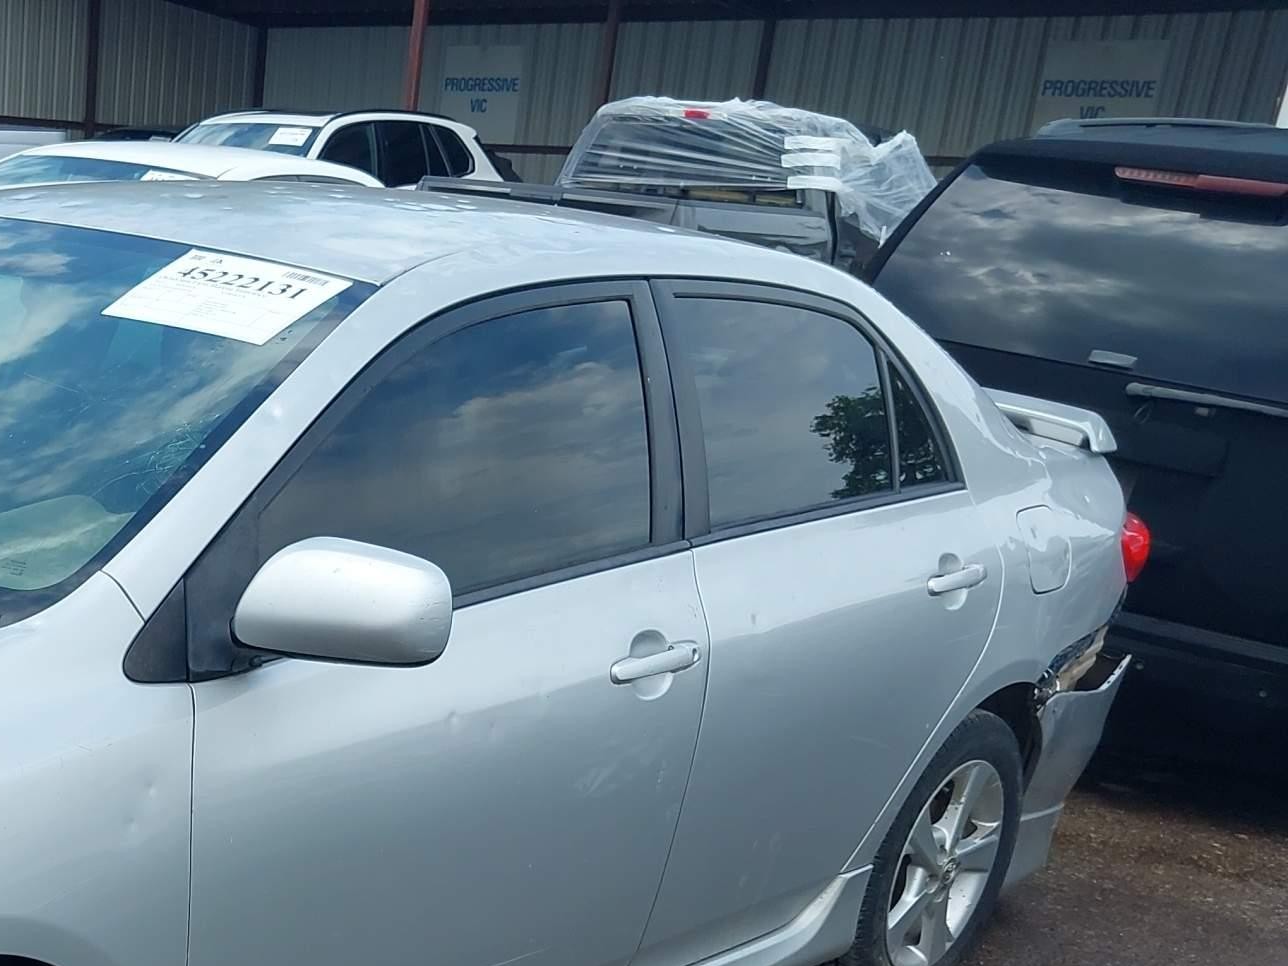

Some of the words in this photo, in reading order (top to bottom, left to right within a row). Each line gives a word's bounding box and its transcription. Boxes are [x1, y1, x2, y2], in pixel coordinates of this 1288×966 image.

[444, 77, 519, 92] PROGRESSIVE
[1041, 79, 1156, 98] PROGRESSIVE
[470, 98, 487, 112] VIC
[177, 266, 307, 299] 45222131
